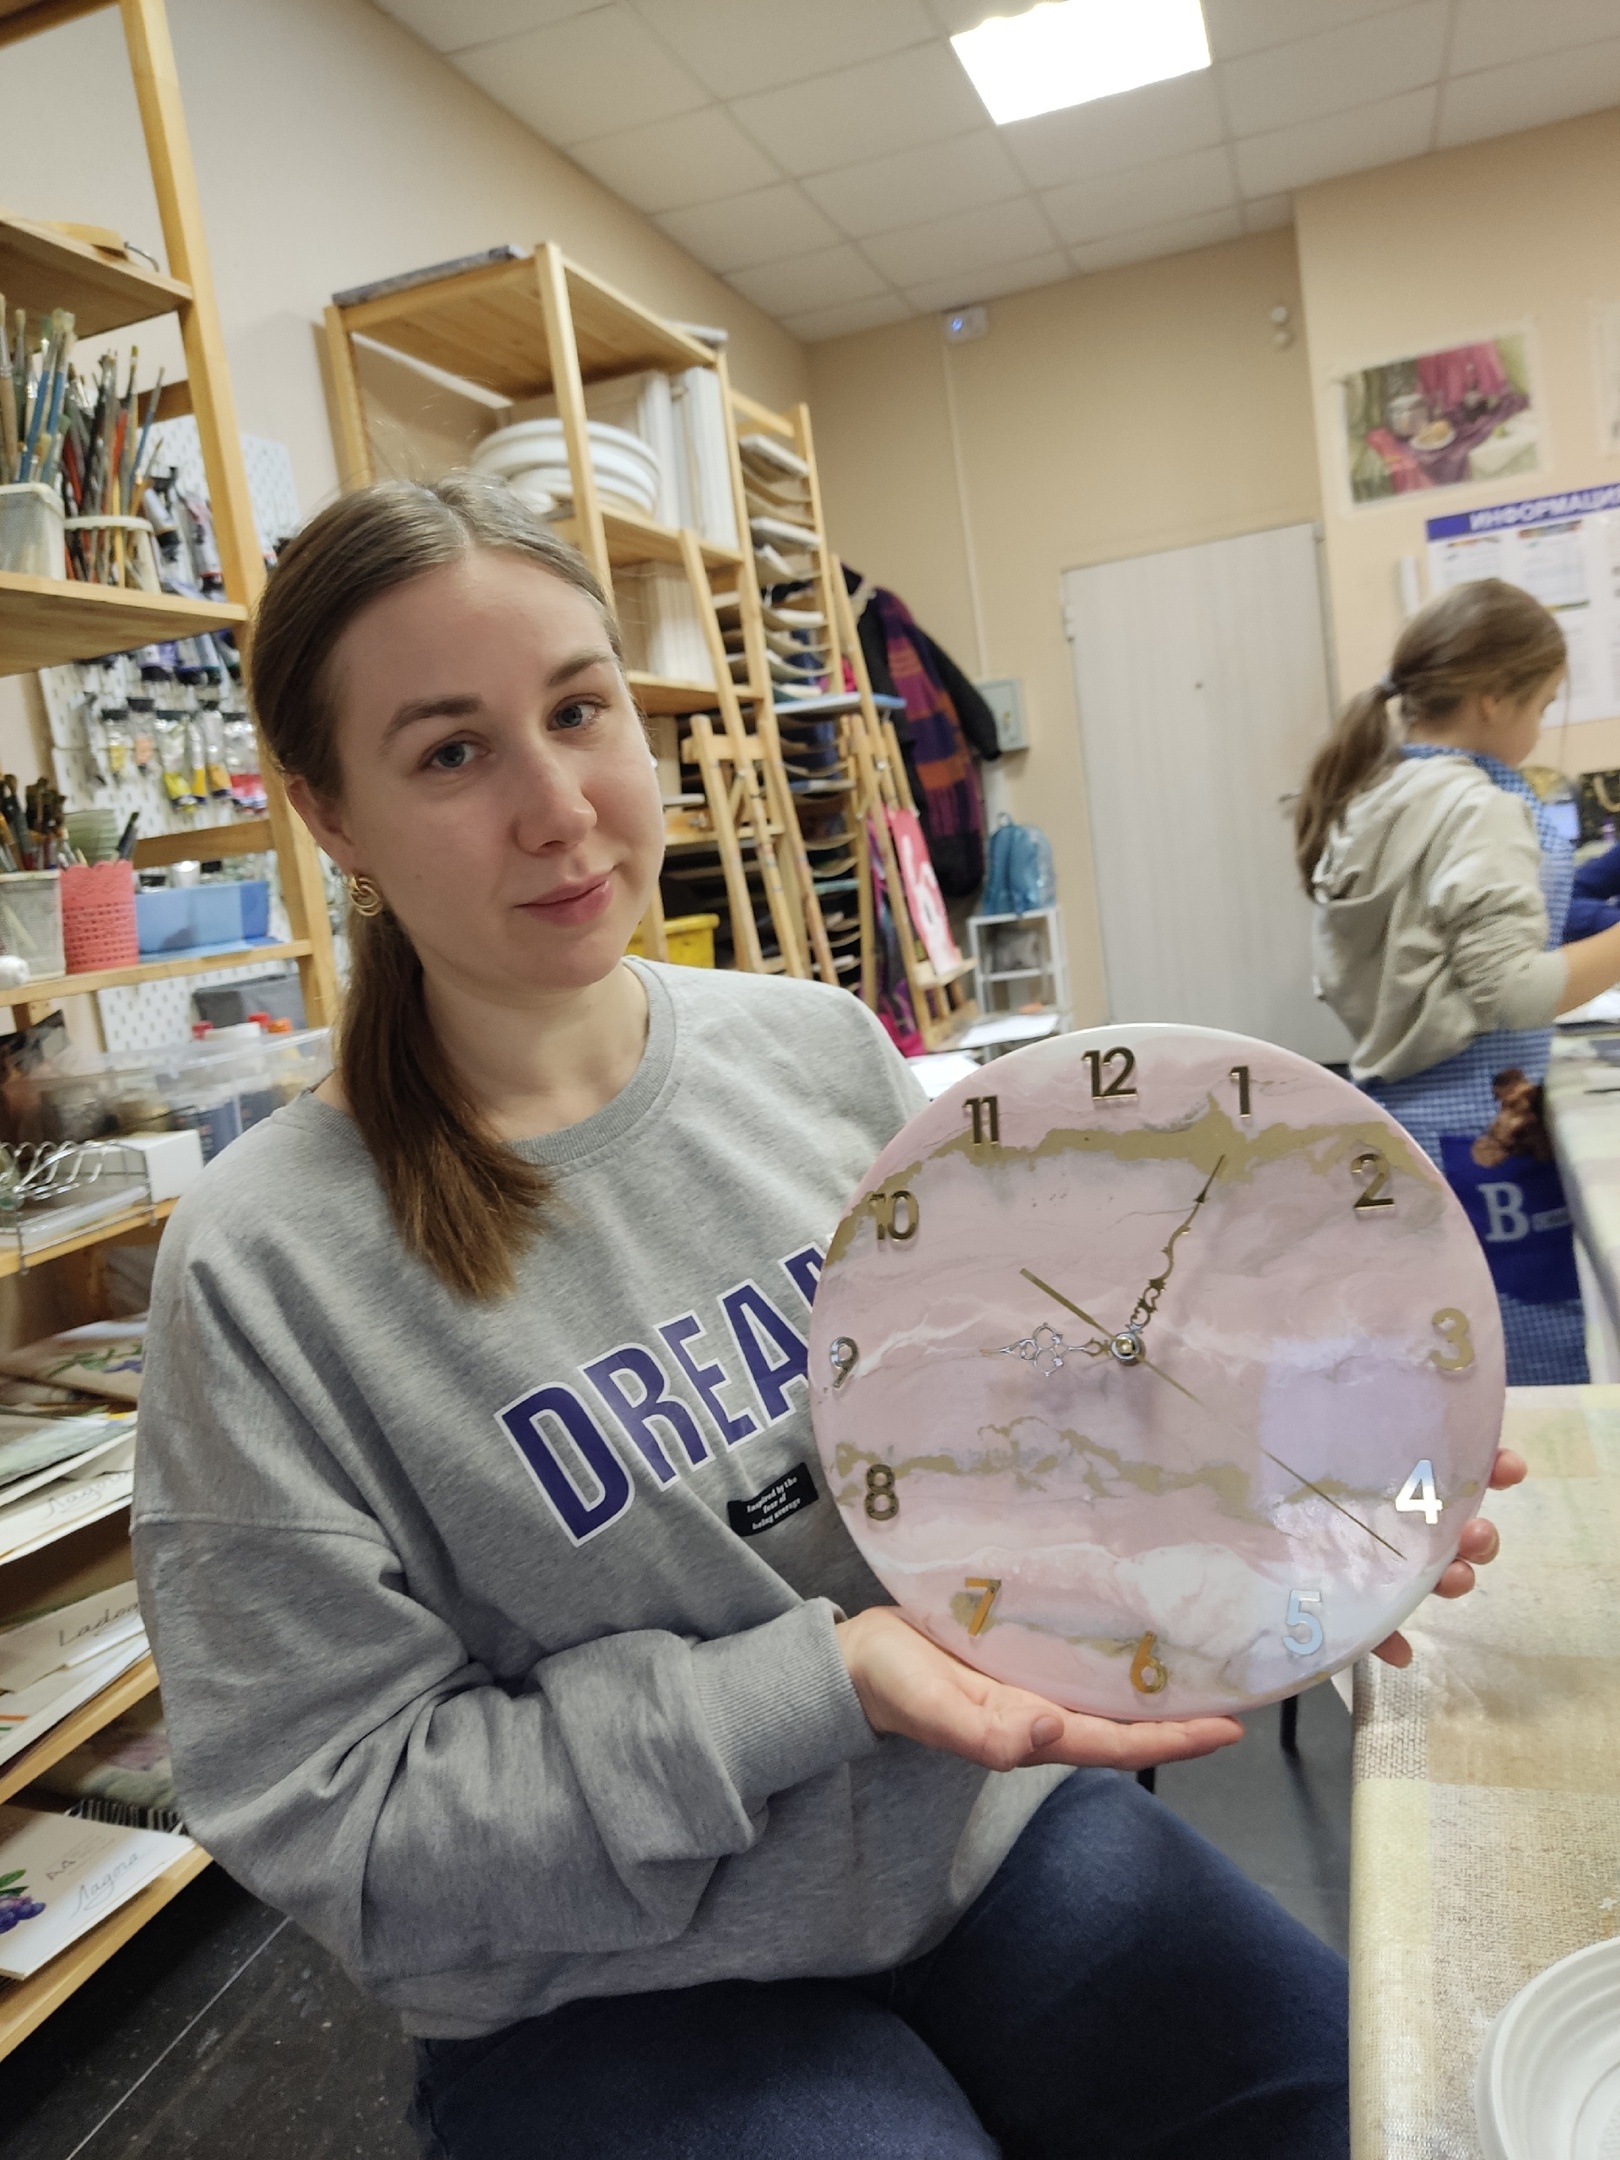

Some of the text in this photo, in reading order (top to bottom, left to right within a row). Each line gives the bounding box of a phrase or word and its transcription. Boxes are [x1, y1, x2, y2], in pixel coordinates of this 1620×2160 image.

[1082, 1047, 1138, 1100] 12
[1230, 1065, 1252, 1118] 1
[964, 1096, 1001, 1146] 11
[1351, 1153, 1394, 1211] 2
[868, 1190, 920, 1241] 10
[829, 1336, 859, 1389] 9
[1430, 1308, 1475, 1372] 3
[493, 1240, 826, 1548] DREA
[752, 1498, 800, 1530] being average
[864, 1464, 899, 1521] 8
[1395, 1460, 1443, 1525] 4
[965, 1578, 1001, 1637] 7
[1281, 1590, 1324, 1655] 5
[1128, 1630, 1168, 1694] 6
